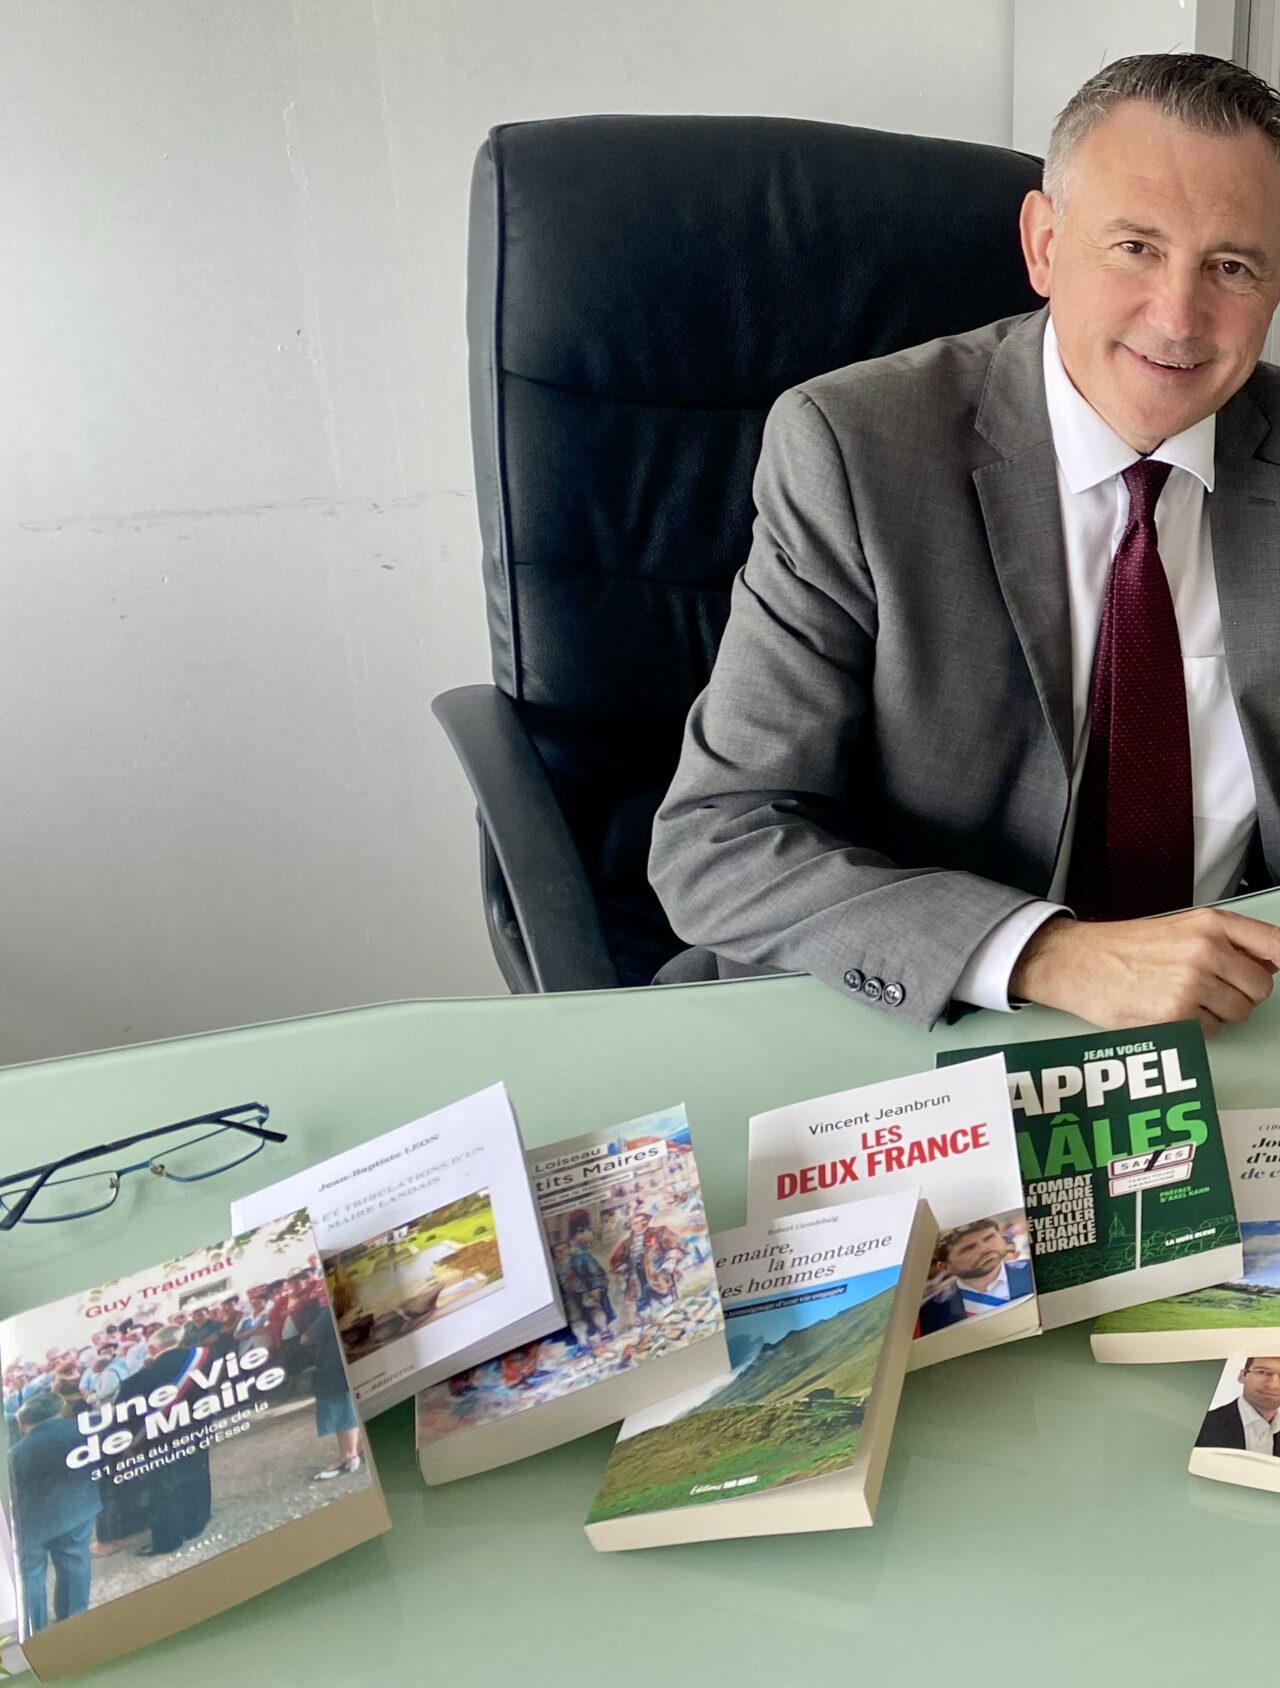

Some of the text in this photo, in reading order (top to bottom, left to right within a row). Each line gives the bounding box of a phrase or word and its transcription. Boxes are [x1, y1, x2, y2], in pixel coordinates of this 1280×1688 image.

[1083, 1041, 1156, 1061] JEAN VOGEL
[1006, 1048, 1197, 1117] APPEL
[809, 1094, 951, 1136] Vincent Jeanbrun
[861, 1125, 903, 1151] LES
[318, 1152, 402, 1192] Jean-Baptiste
[535, 1148, 600, 1173] Loiseau
[536, 1174, 574, 1192] tits
[583, 1147, 659, 1178] Maires
[777, 1123, 989, 1200] DEUX FRANCE
[1241, 1168, 1265, 1180] de
[1026, 1185, 1093, 1208] N MAIRE
[1029, 1173, 1093, 1195] COMBAT
[1028, 1208, 1095, 1232] ÉVEILLER
[1051, 1197, 1094, 1215] POUR
[1035, 1231, 1096, 1255] RURALE
[1036, 1220, 1096, 1242] FRANCE
[731, 1243, 794, 1265] maire,
[768, 1235, 892, 1273] la montagne
[84, 1256, 235, 1320] Guy Traumat
[747, 1263, 836, 1293] hommes
[77, 1347, 270, 1436] Une Vie
[65, 1366, 286, 1470] de Maire
[90, 1400, 269, 1482] 31 ans au service de la
[112, 1444, 195, 1485] commune
